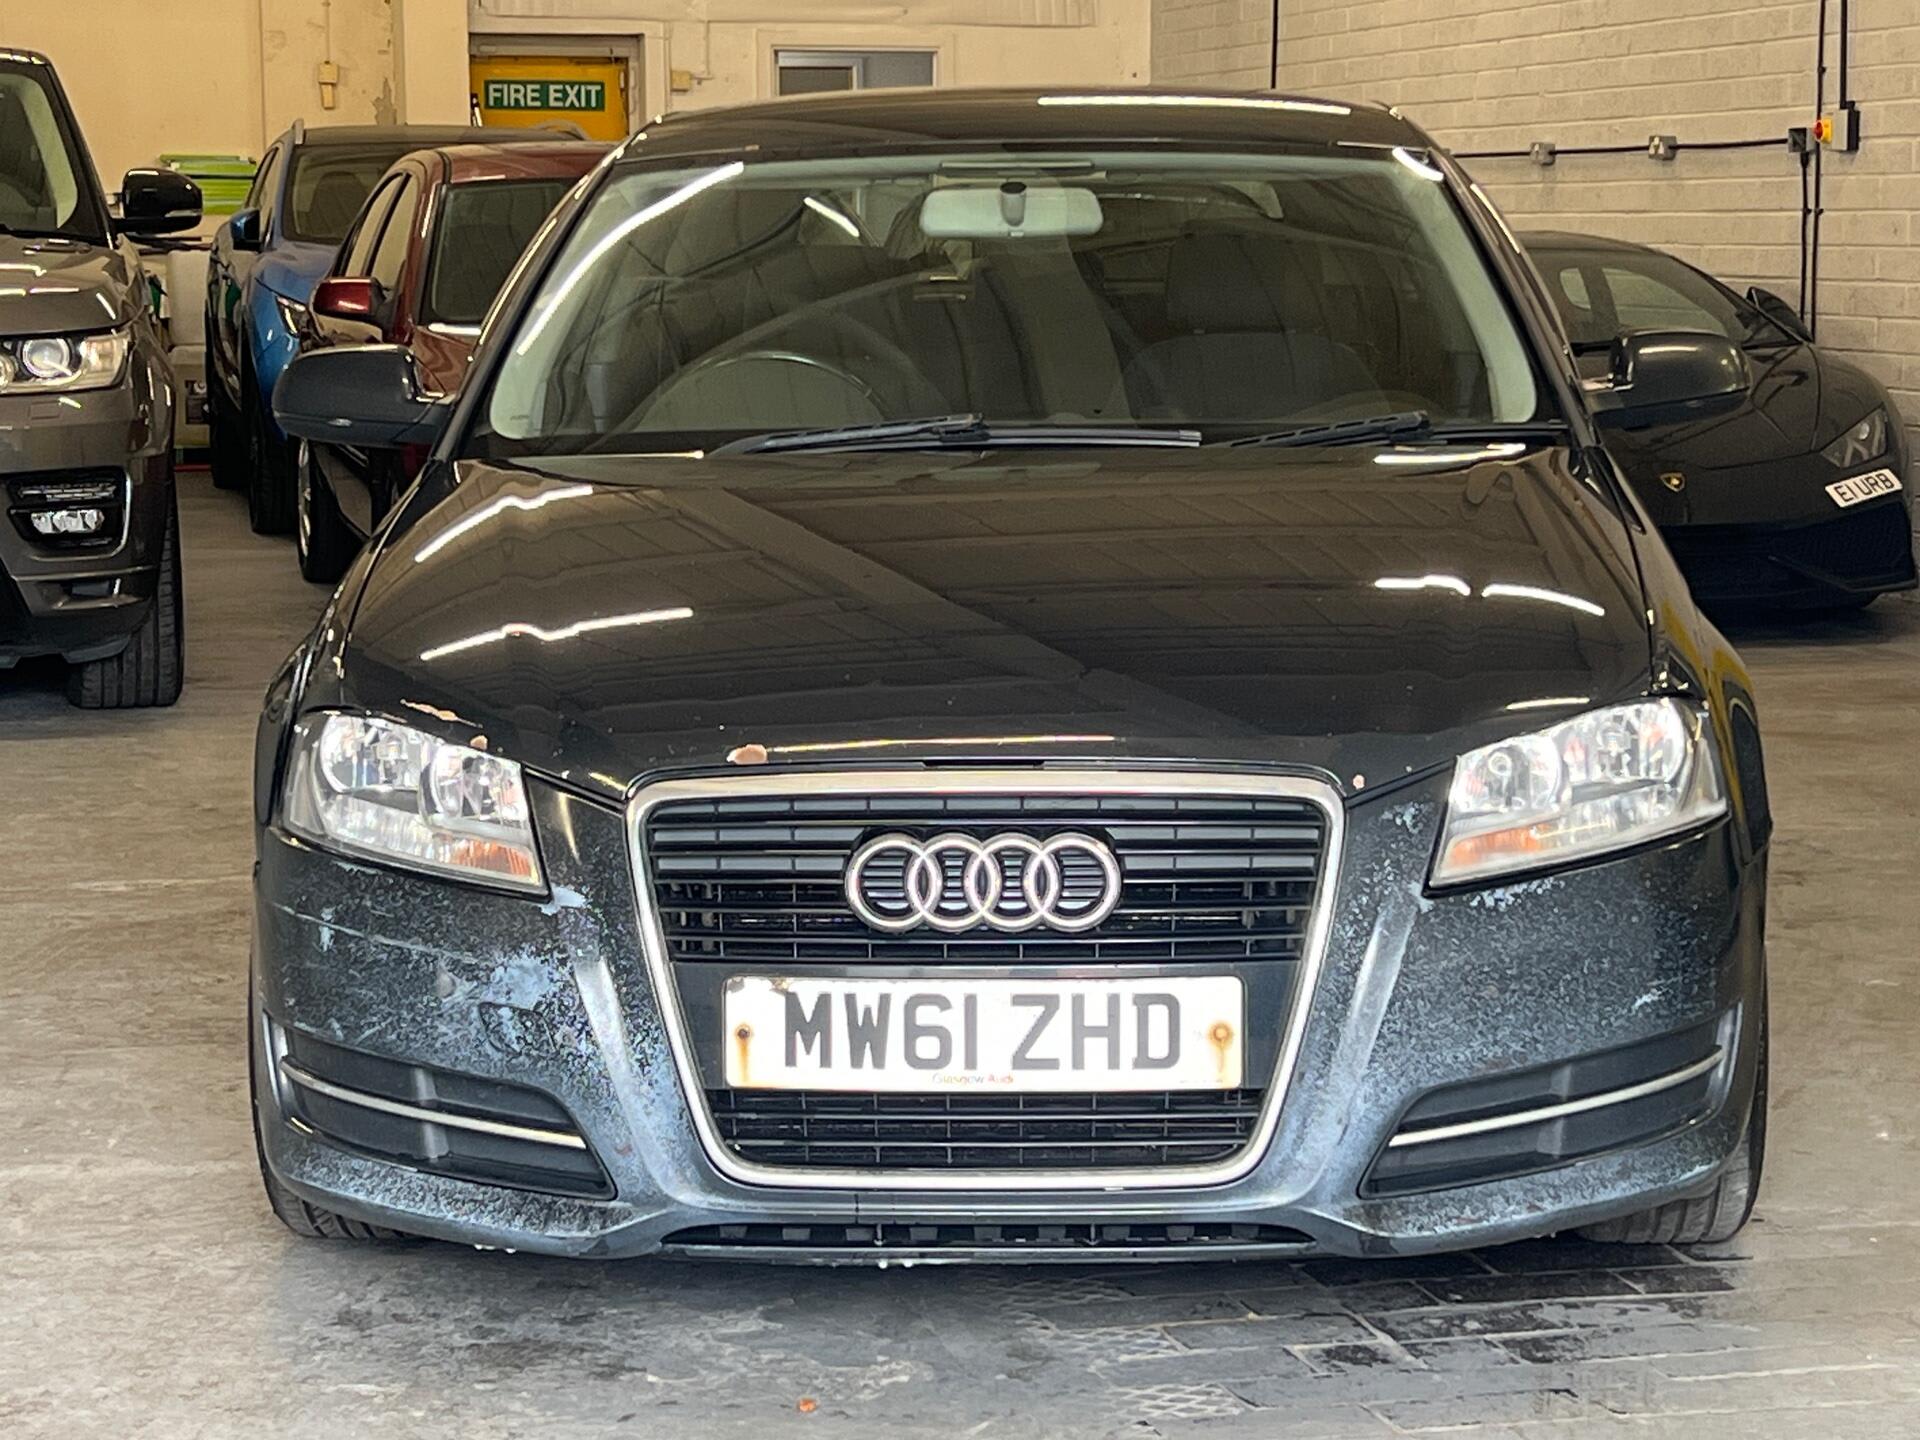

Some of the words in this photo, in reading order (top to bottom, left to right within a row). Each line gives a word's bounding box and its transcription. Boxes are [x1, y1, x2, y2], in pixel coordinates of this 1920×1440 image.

[488, 84, 541, 107] FIRE
[548, 84, 602, 108] EXIT
[784, 992, 978, 1070] MW61
[1011, 992, 1181, 1070] ZHD
